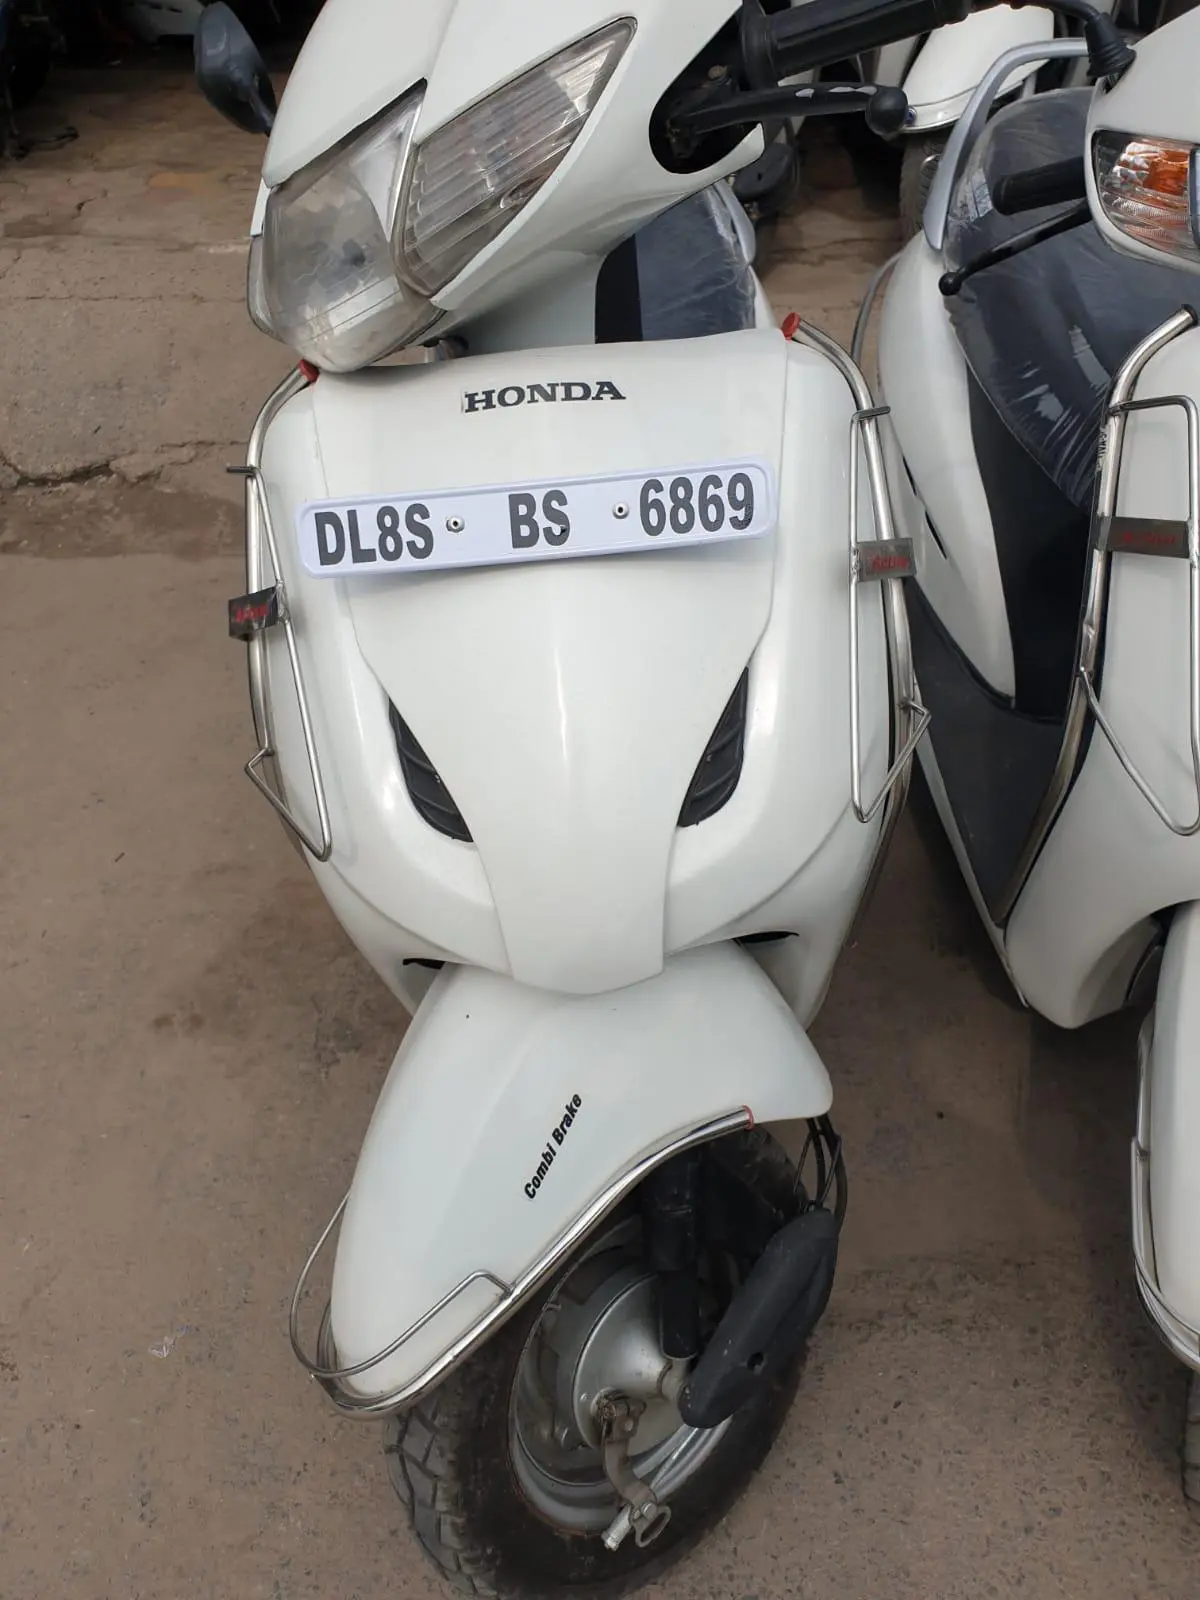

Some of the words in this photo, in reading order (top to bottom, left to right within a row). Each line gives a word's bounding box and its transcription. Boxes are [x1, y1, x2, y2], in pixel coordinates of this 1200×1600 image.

[464, 381, 627, 414] HONDA
[314, 502, 434, 566] DL8S
[508, 489, 571, 549] BS
[639, 472, 755, 538] 6869
[524, 1142, 557, 1199] Combi
[552, 1093, 582, 1146] Brake
